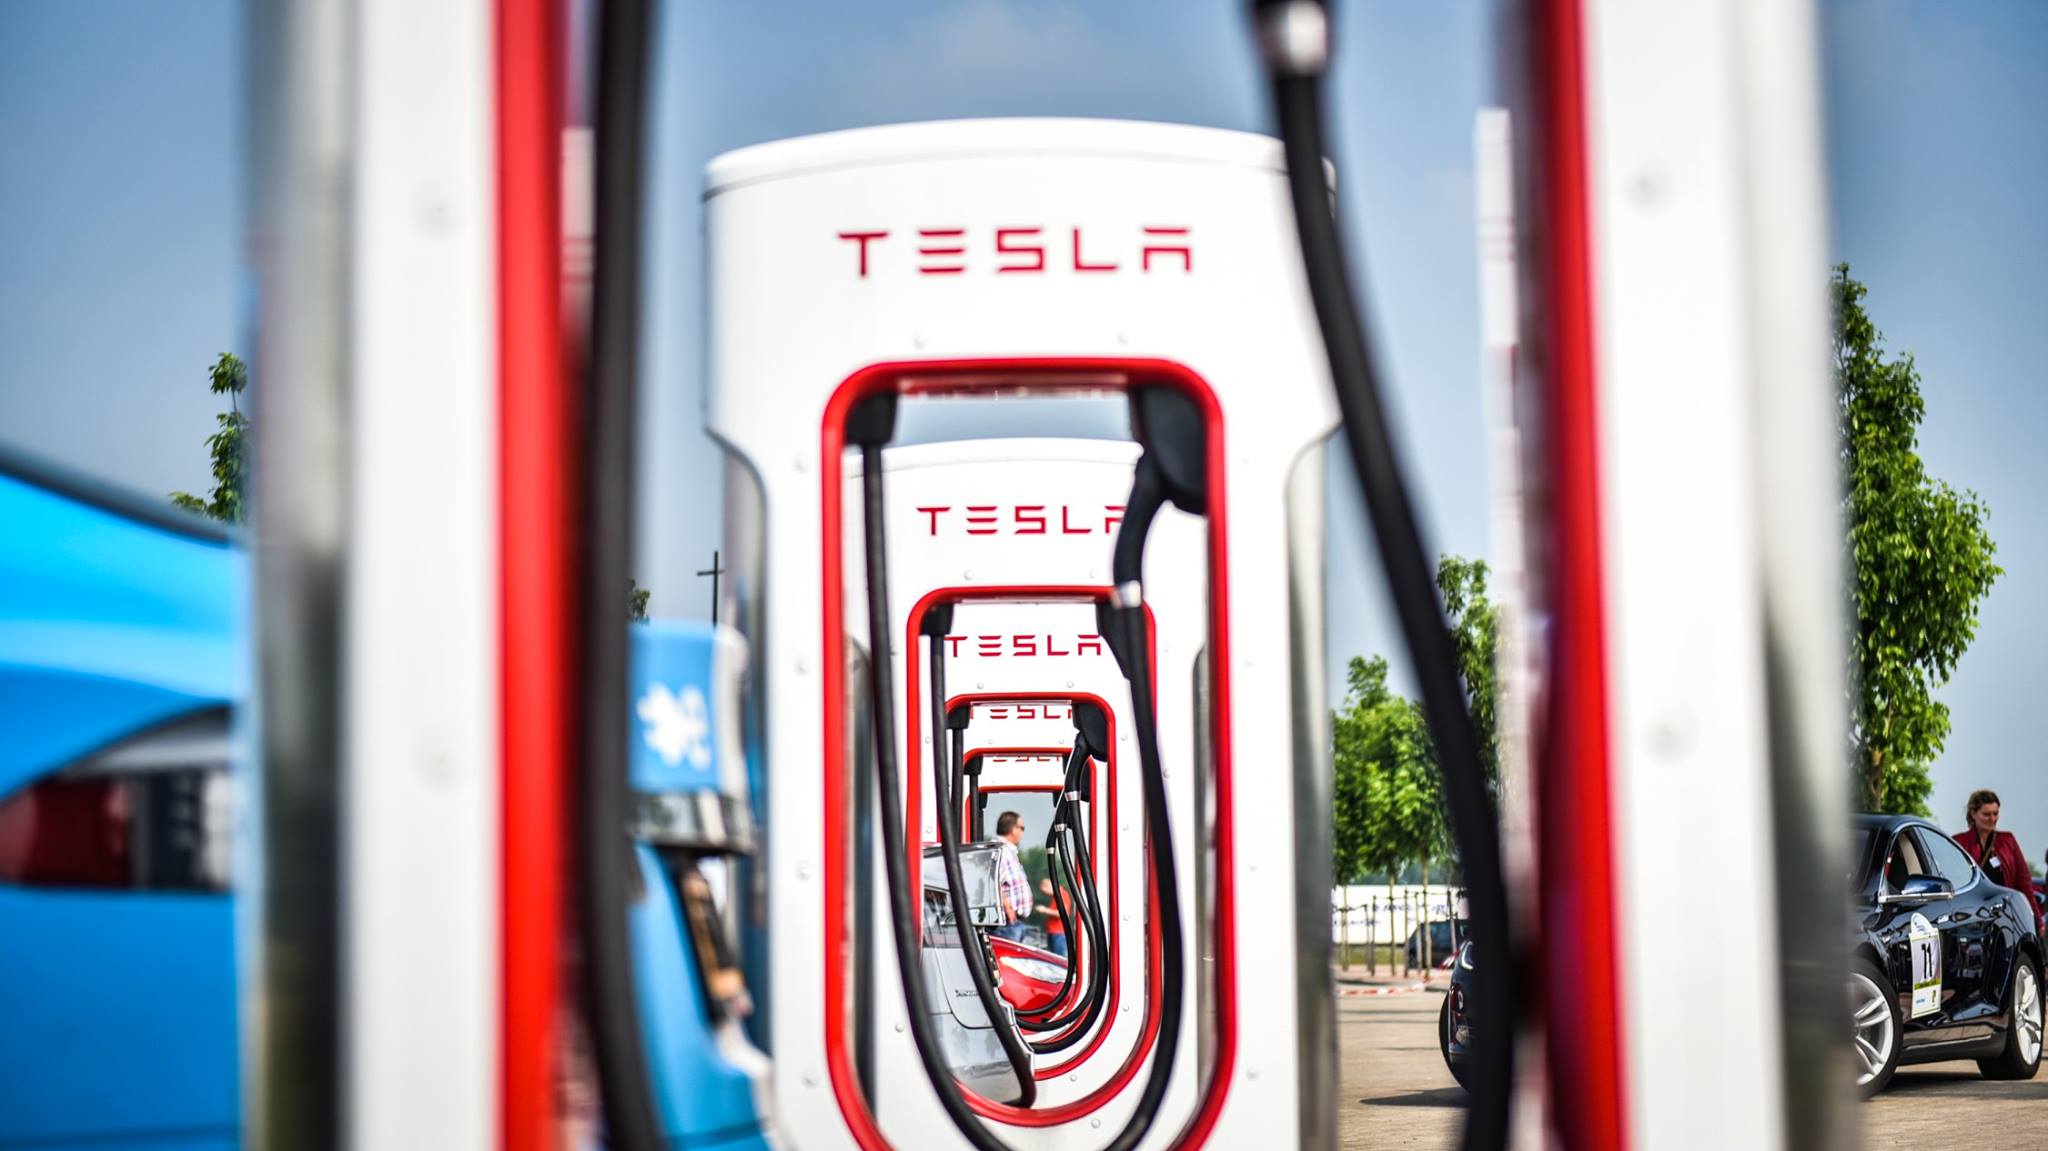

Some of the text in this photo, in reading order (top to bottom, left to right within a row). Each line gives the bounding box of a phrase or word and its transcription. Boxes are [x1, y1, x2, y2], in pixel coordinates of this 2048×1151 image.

[837, 227, 1192, 277] TESLA
[944, 634, 1101, 657] TESLA
[970, 705, 1072, 719] ESL
